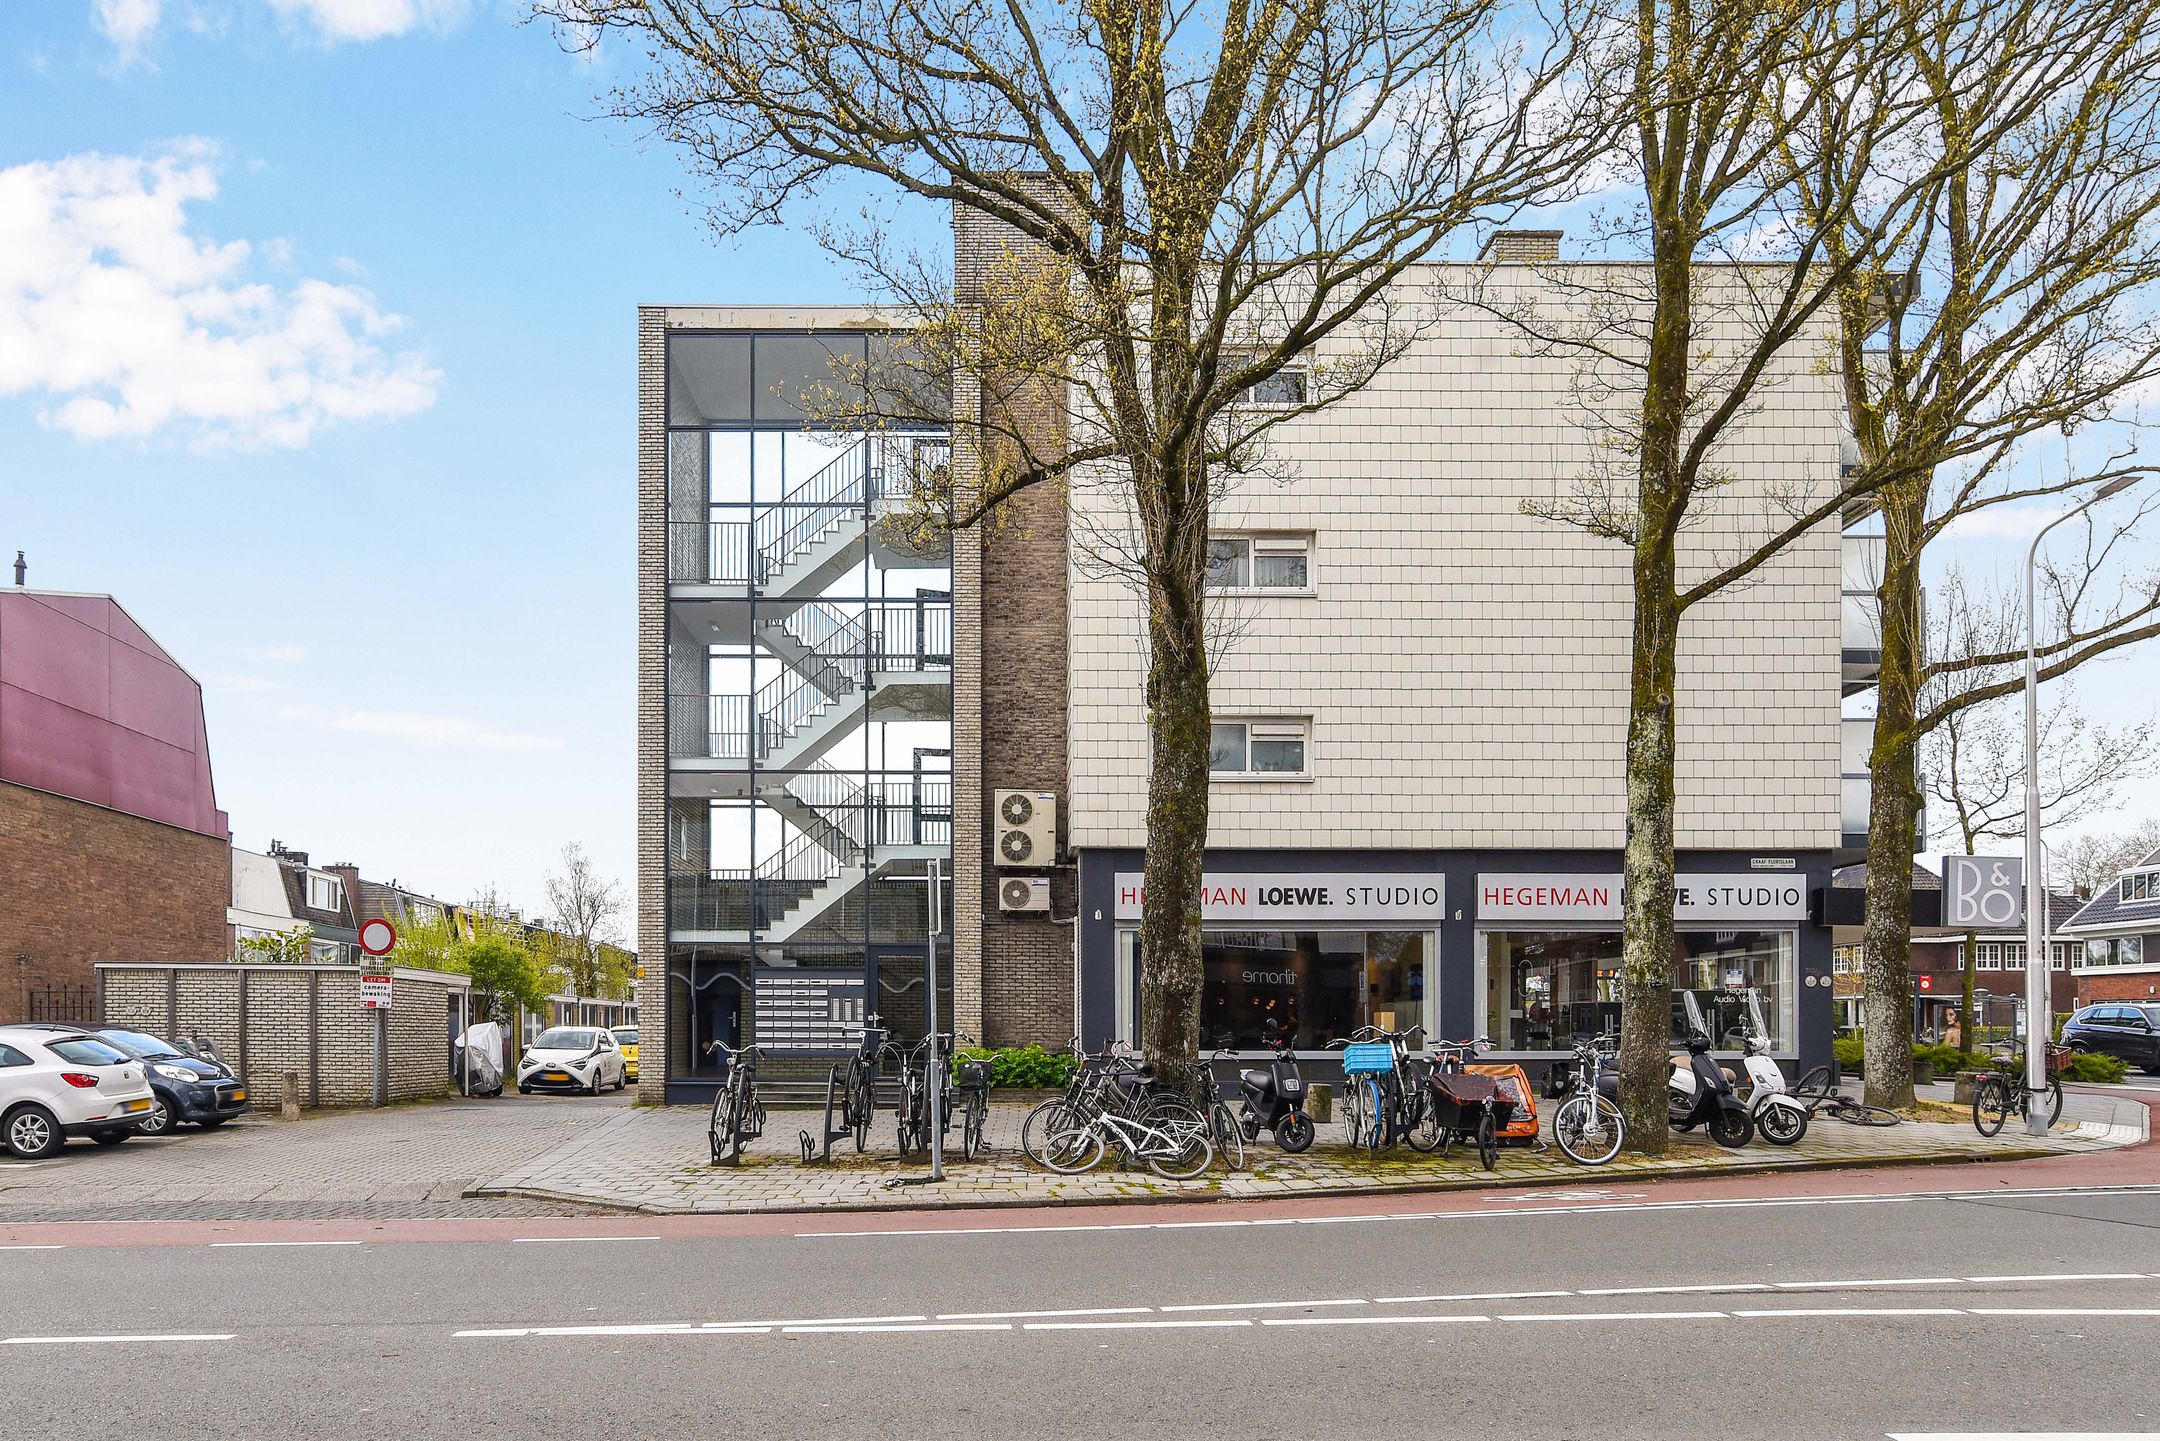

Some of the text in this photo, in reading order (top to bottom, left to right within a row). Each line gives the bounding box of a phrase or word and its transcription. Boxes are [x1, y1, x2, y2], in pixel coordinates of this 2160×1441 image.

[1258, 887, 1333, 906] LOEWE.
[1346, 887, 1439, 906] STUDIO
[1484, 887, 1609, 907] HEGEMAN
[1707, 887, 1800, 907] STUDIO
[1713, 995, 1736, 1003] Audio
